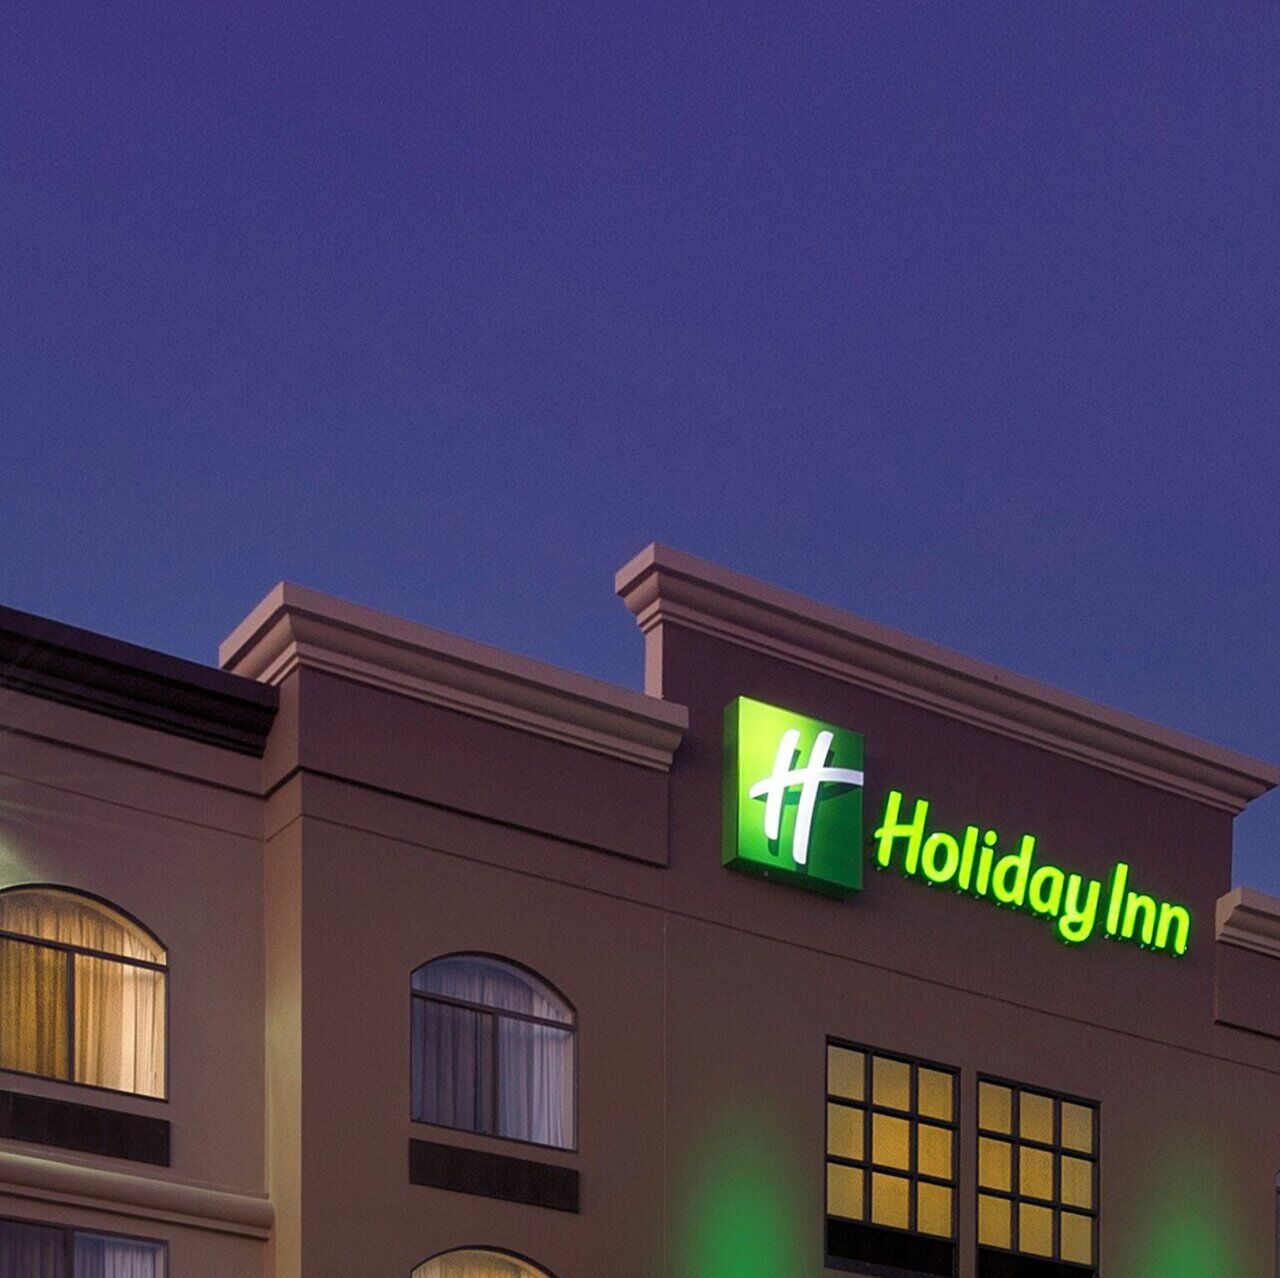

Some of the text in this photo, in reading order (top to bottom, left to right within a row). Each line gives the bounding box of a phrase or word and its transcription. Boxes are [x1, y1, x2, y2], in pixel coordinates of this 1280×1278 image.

[750, 729, 864, 865] H
[873, 790, 1191, 956] Holiday Inn
